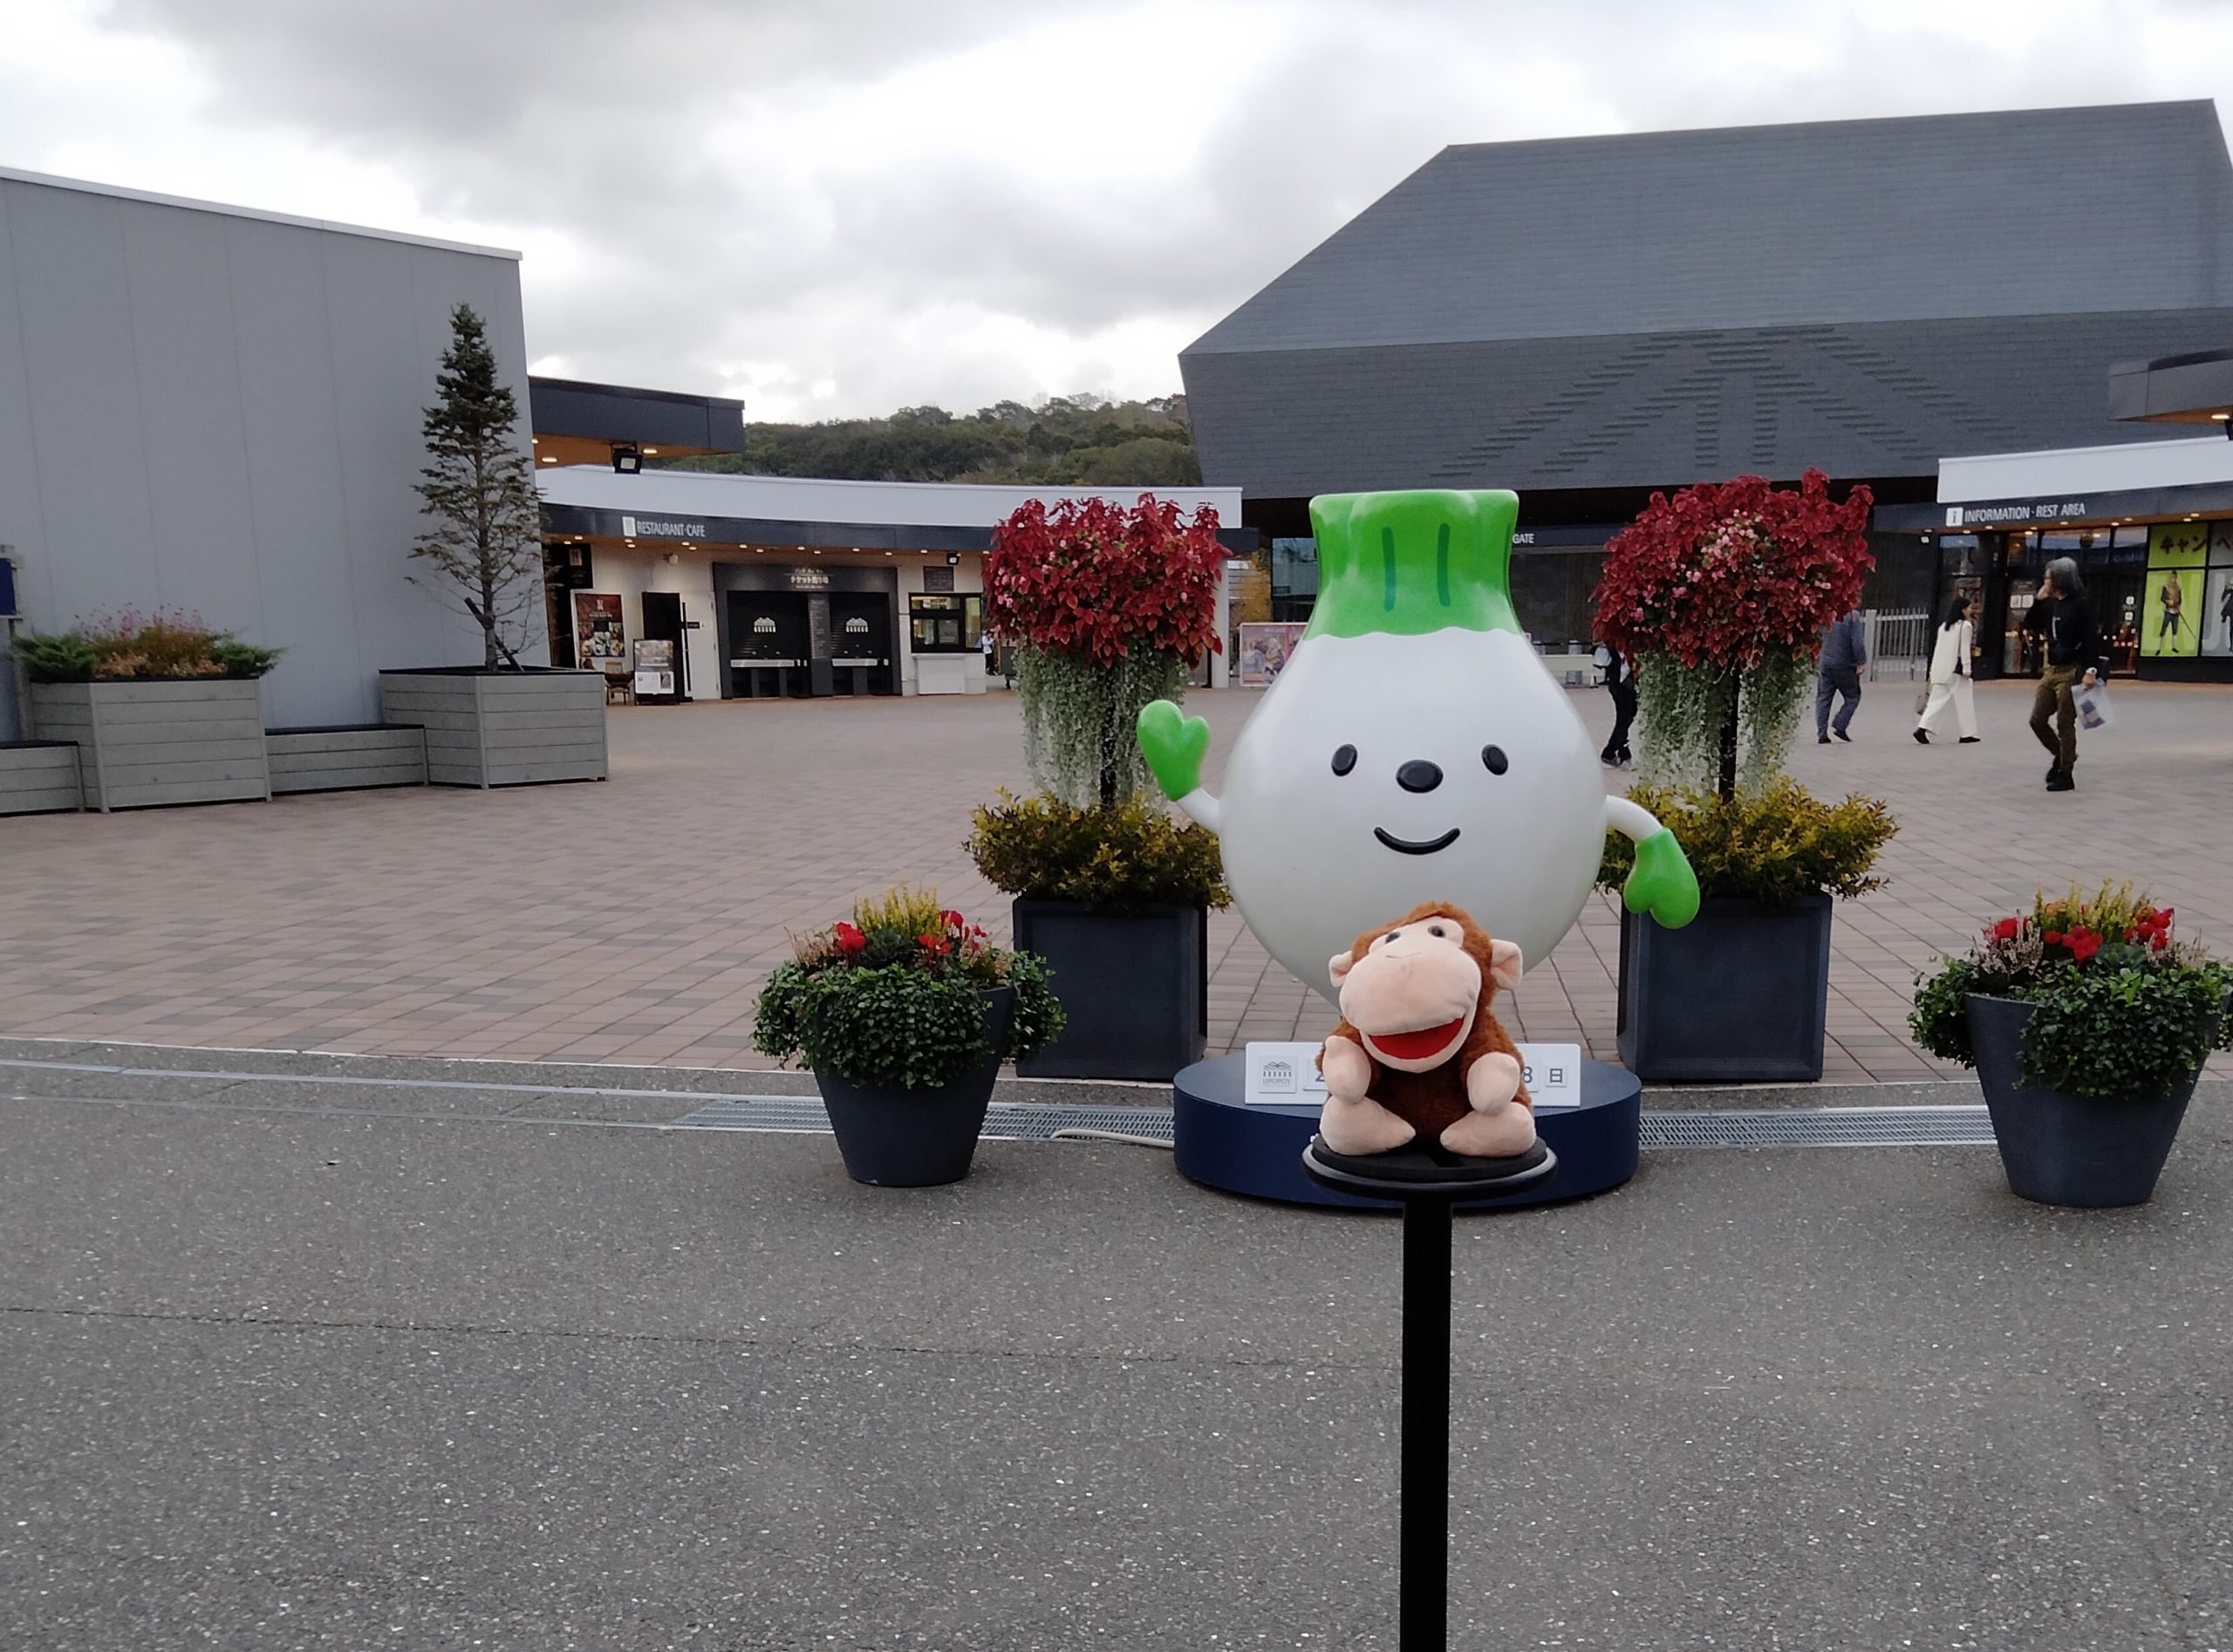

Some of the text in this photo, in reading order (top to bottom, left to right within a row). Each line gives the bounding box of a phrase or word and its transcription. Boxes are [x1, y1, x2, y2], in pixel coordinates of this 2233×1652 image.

[1964, 507, 2030, 522] INFORMATION
[2036, 504, 2059, 518] REST
[2060, 503, 2086, 516] AREA
[1513, 533, 1535, 544] GATE
